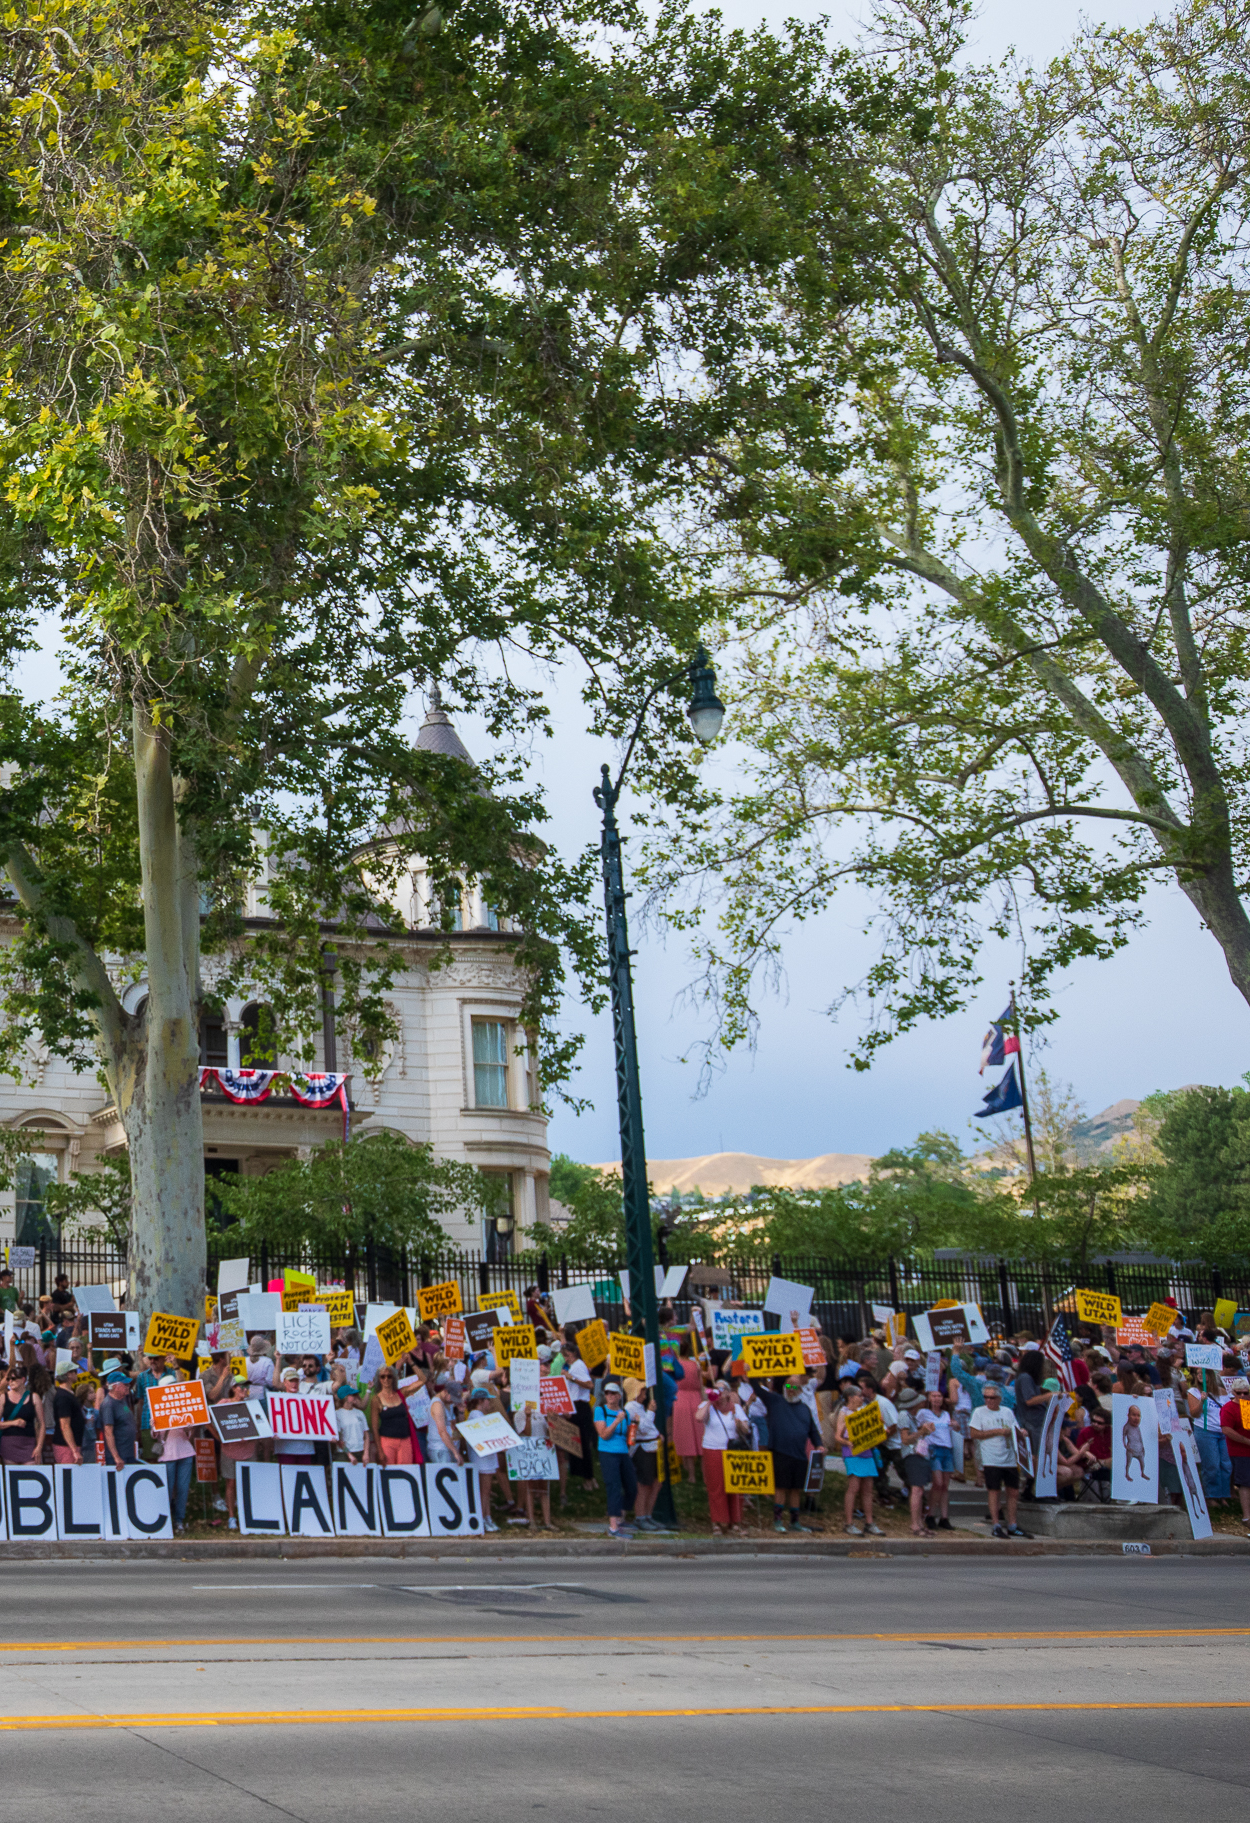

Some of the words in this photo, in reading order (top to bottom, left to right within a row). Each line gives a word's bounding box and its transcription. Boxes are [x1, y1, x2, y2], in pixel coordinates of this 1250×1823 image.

[420, 1283, 454, 1296] Protect
[315, 1294, 350, 1302] Protege
[424, 1290, 454, 1303] WILD
[326, 1302, 348, 1312] TAH
[425, 1299, 456, 1314] UTAH
[1084, 1299, 1115, 1311] WILD
[1084, 1308, 1117, 1322] UTAH
[155, 1316, 196, 1328] Protect
[283, 1316, 320, 1329] LICK
[378, 1312, 405, 1334] Protect
[158, 1324, 190, 1339] WILD
[283, 1330, 322, 1340] ROCKS
[383, 1321, 406, 1342] WILD
[496, 1328, 532, 1336] Protect
[152, 1336, 189, 1352] UTAH
[386, 1332, 411, 1357] UTAH
[500, 1335, 530, 1346] WILD
[612, 1336, 642, 1347] Protect
[747, 1336, 795, 1346] Protect
[501, 1348, 532, 1360] UTAH
[616, 1344, 640, 1358] WILD
[752, 1345, 793, 1356] WILD
[614, 1358, 641, 1372] UTAH
[753, 1358, 796, 1370] UTAH
[165, 1386, 186, 1394] SAVE
[161, 1392, 192, 1401] GRAND
[154, 1398, 202, 1409] STAIRCASE
[155, 1405, 204, 1417] ESCALANTE
[270, 1397, 336, 1435] HONK
[851, 1417, 879, 1437] UTAH
[726, 1453, 768, 1461] Protect
[731, 1462, 766, 1473] WILD
[731, 1476, 768, 1486] UTAH
[241, 1466, 479, 1533] LANDS!
